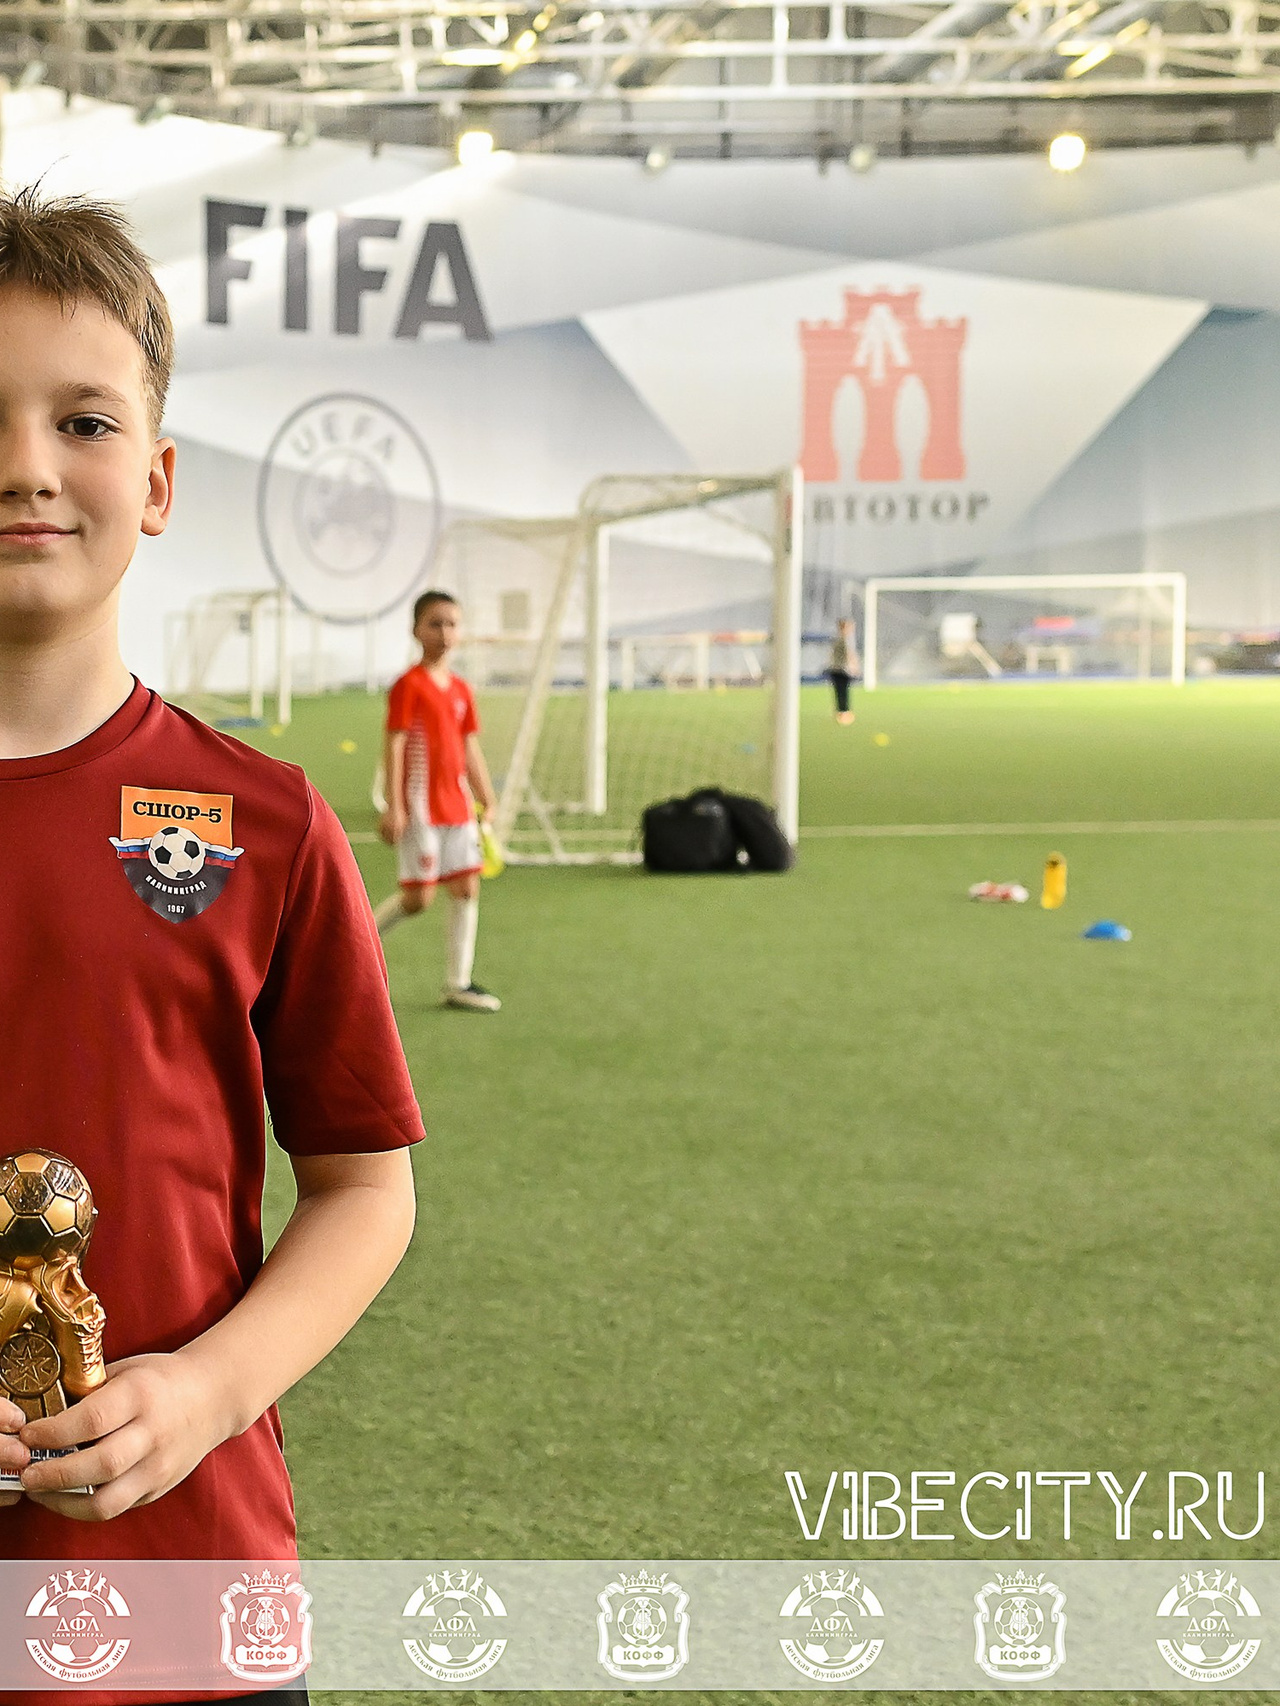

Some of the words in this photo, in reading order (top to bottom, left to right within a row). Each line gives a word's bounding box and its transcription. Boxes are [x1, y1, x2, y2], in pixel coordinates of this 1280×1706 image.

[204, 197, 494, 342] FIFA
[290, 412, 396, 462] UEFA
[811, 491, 990, 524] ВТОТОР
[132, 801, 222, 823] СШОР-5
[145, 875, 207, 895] КАЛИНИНГРАД
[167, 904, 185, 914] 1967
